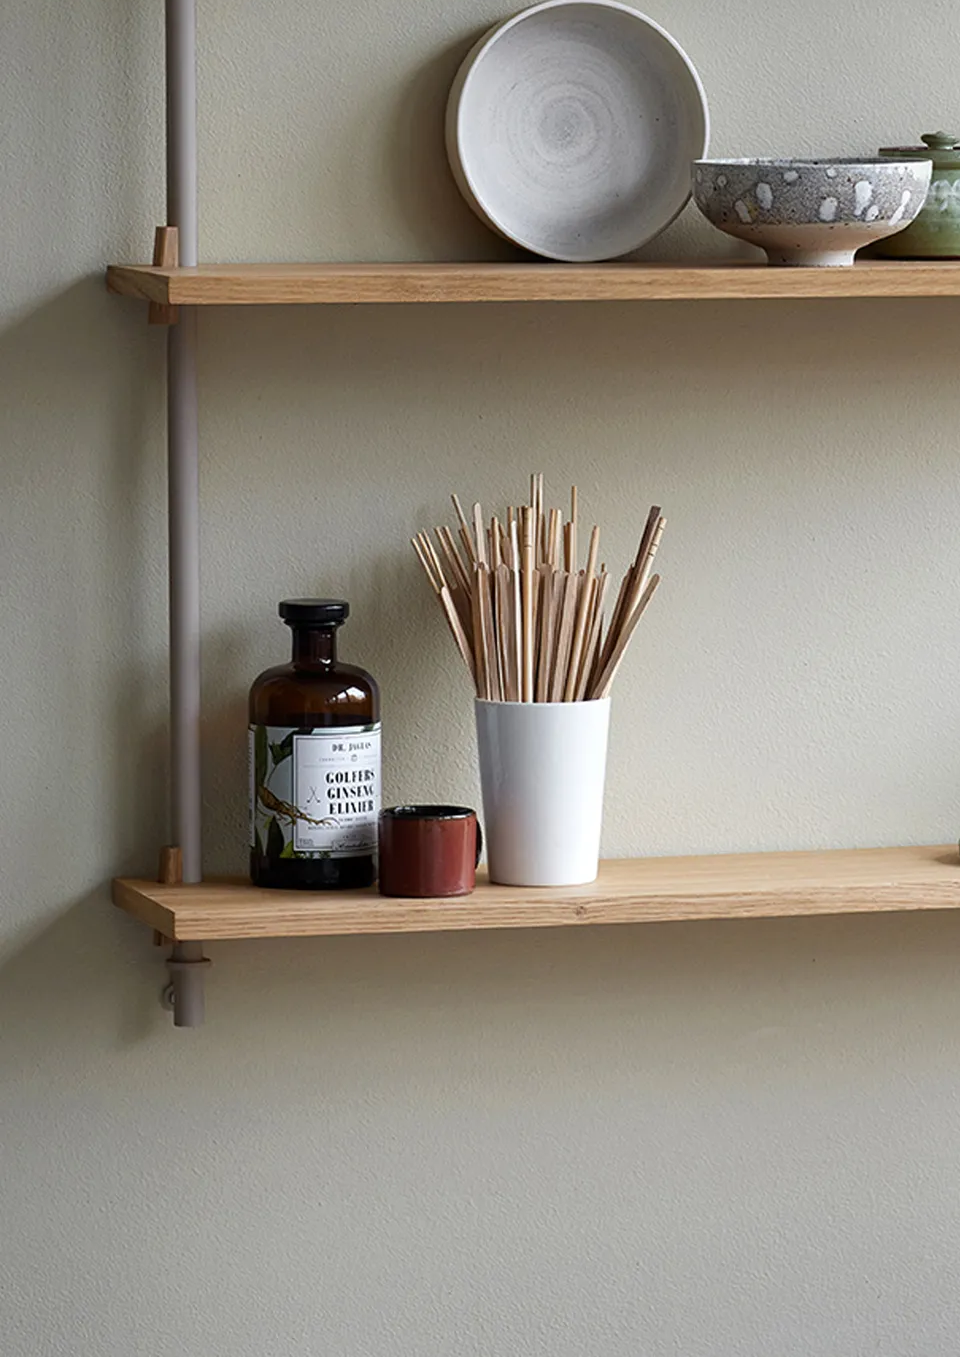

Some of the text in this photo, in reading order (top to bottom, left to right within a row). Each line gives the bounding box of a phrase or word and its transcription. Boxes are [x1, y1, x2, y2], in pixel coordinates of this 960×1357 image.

[325, 769, 375, 784] GOLFERS
[327, 784, 374, 799] GINSENG
[330, 800, 374, 815] ELIXIER
